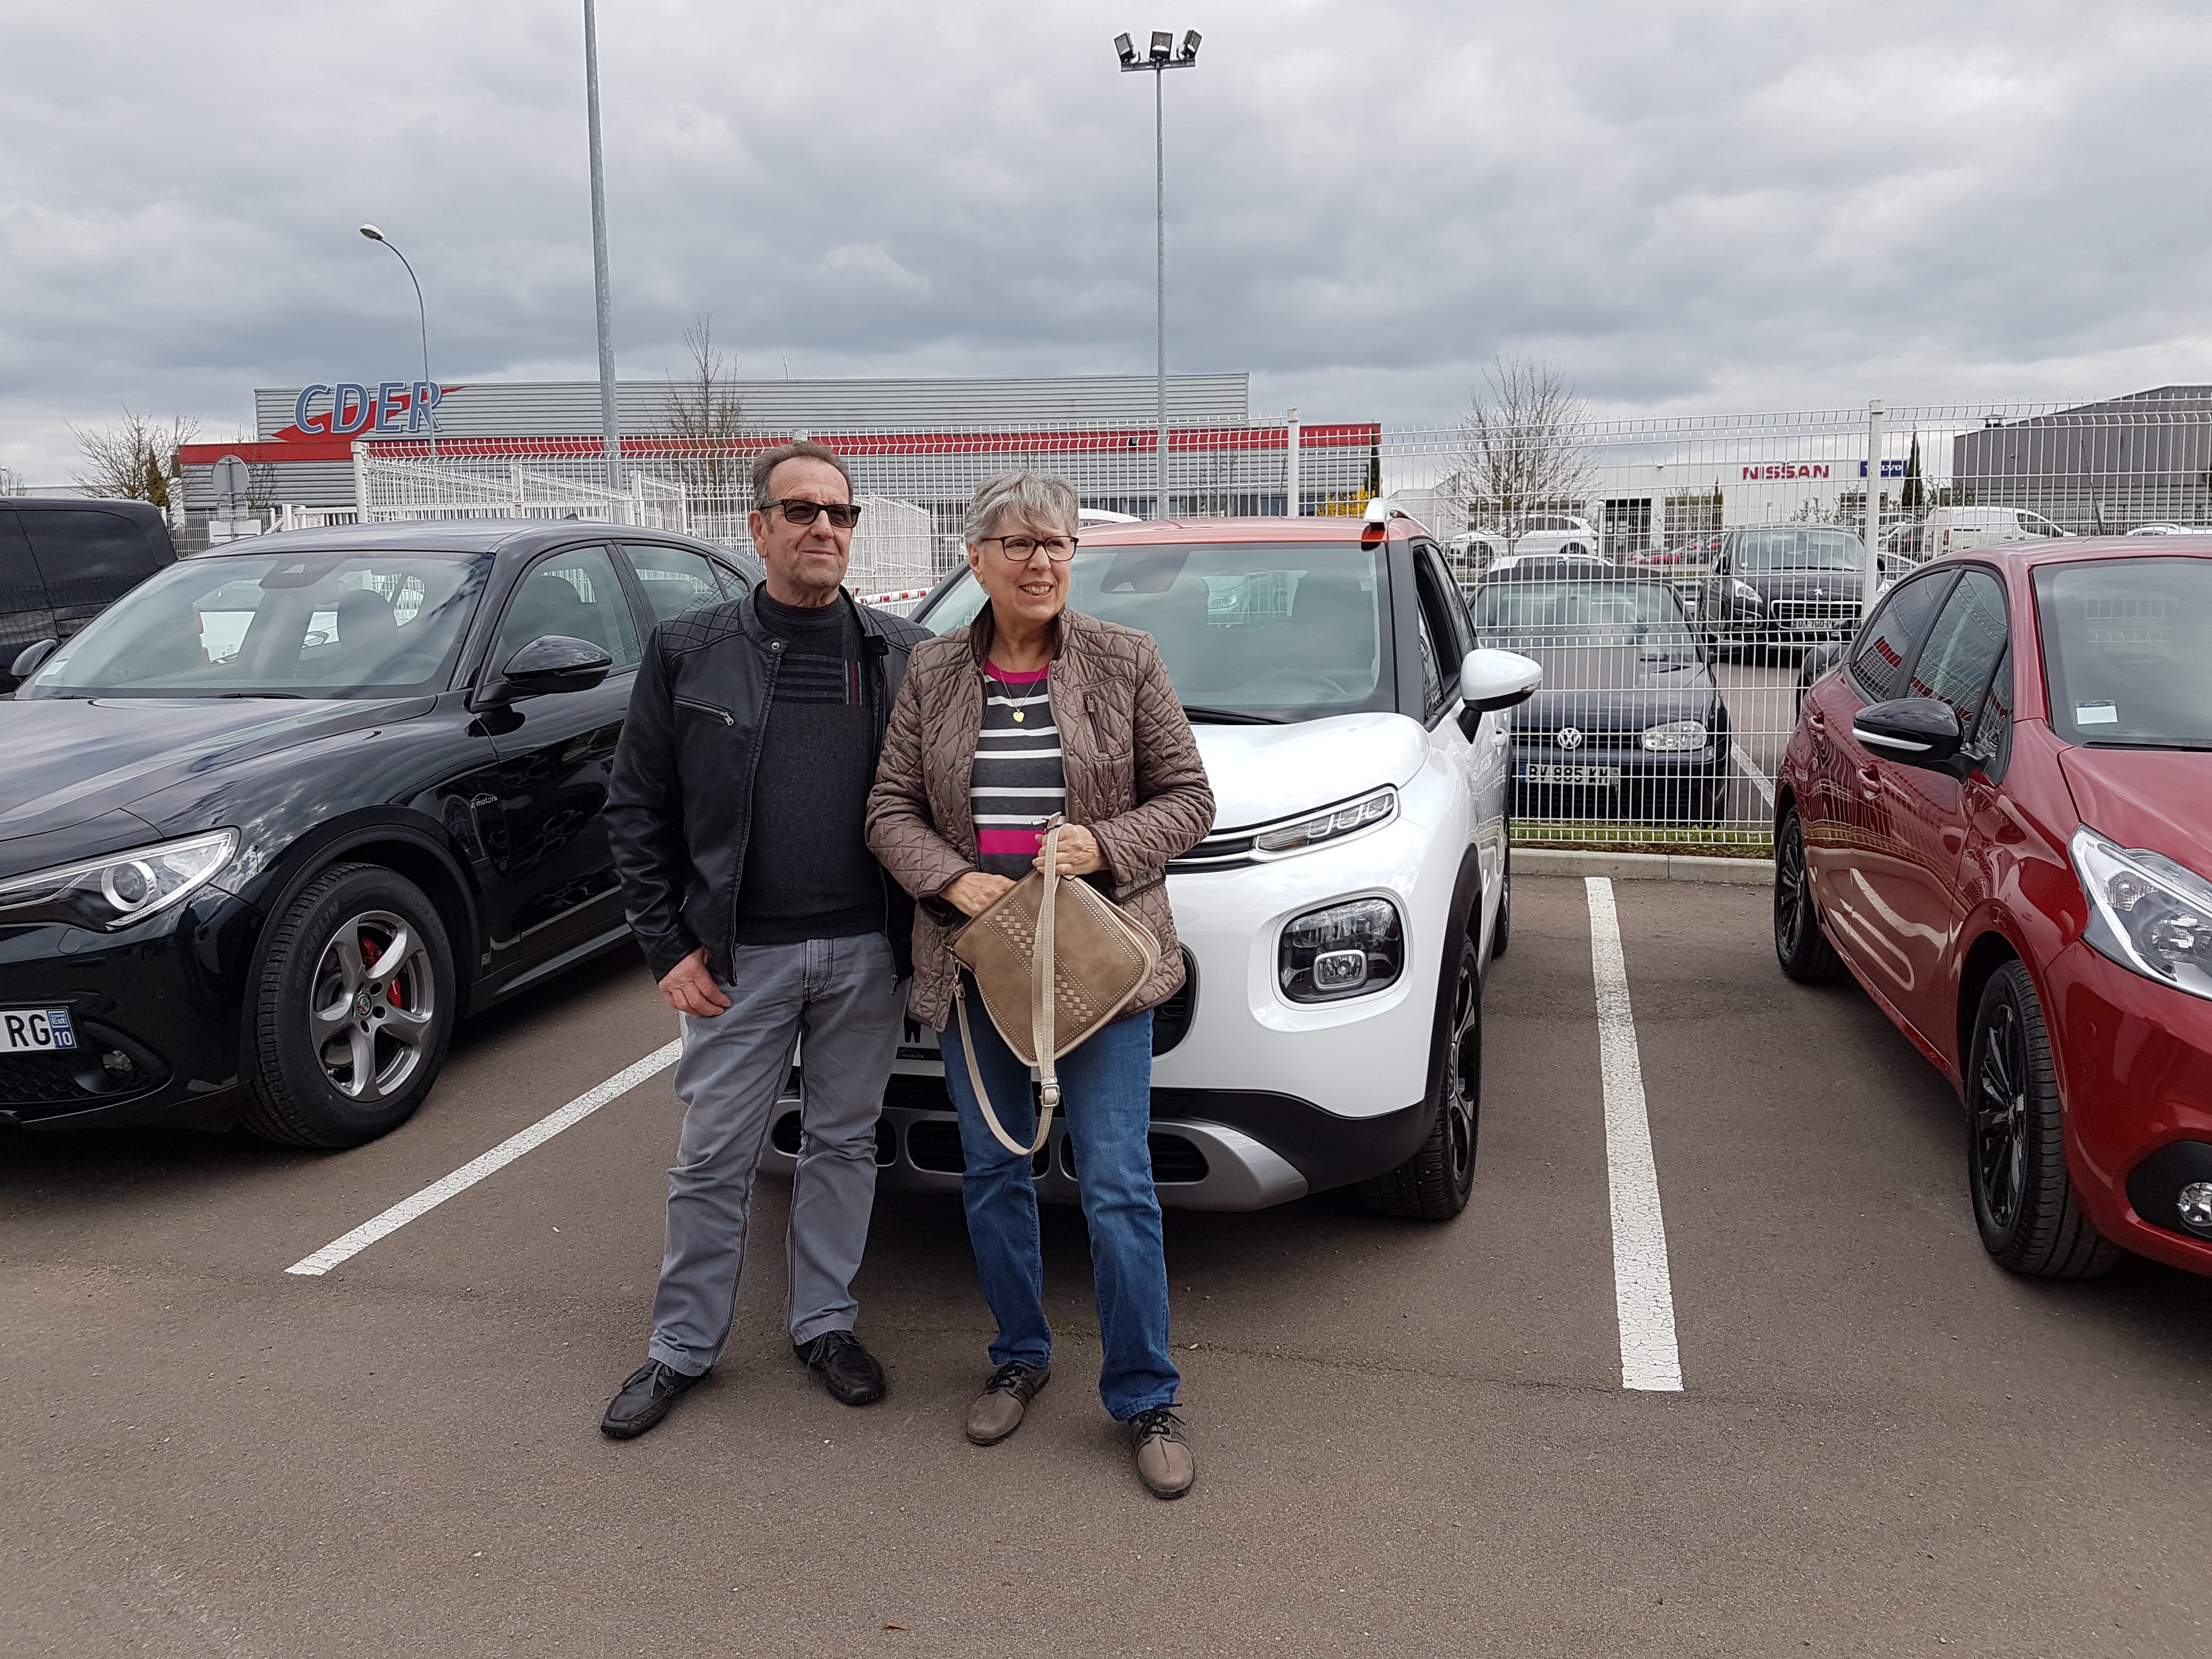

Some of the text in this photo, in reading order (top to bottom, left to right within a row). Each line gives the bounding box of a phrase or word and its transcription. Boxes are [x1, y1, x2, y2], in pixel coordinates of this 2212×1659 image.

[294, 381, 442, 435] CDER
[1743, 464, 1830, 480] NISSAN
[4, 1014, 52, 1048] RG
[54, 1031, 72, 1046] 10
